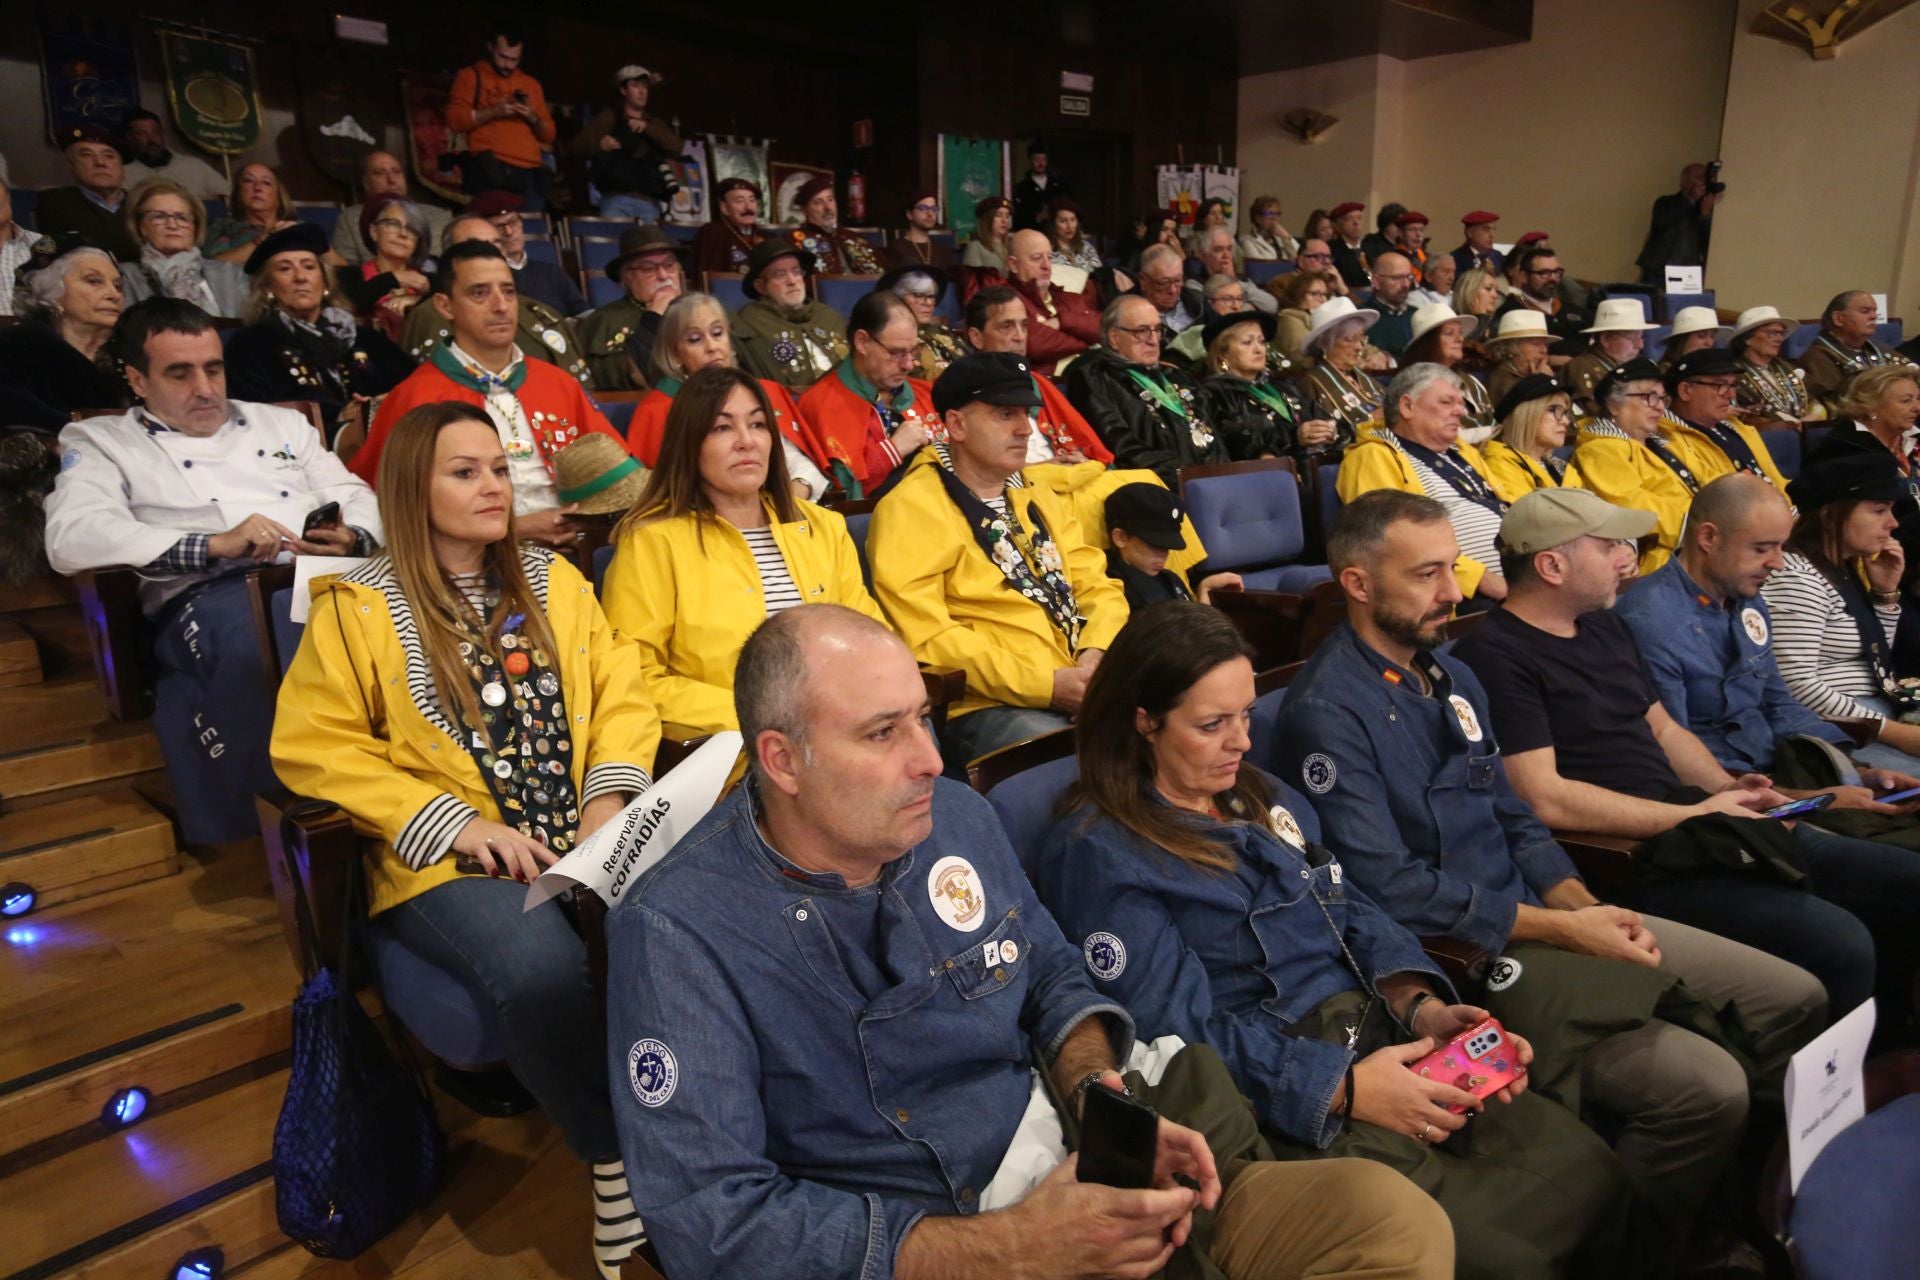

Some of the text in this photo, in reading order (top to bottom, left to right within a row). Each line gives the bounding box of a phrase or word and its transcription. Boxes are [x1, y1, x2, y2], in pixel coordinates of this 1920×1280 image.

[602, 807, 642, 875] Reservado
[610, 797, 671, 898] COFRADÍAS
[632, 1043, 666, 1062] OVIEDO
